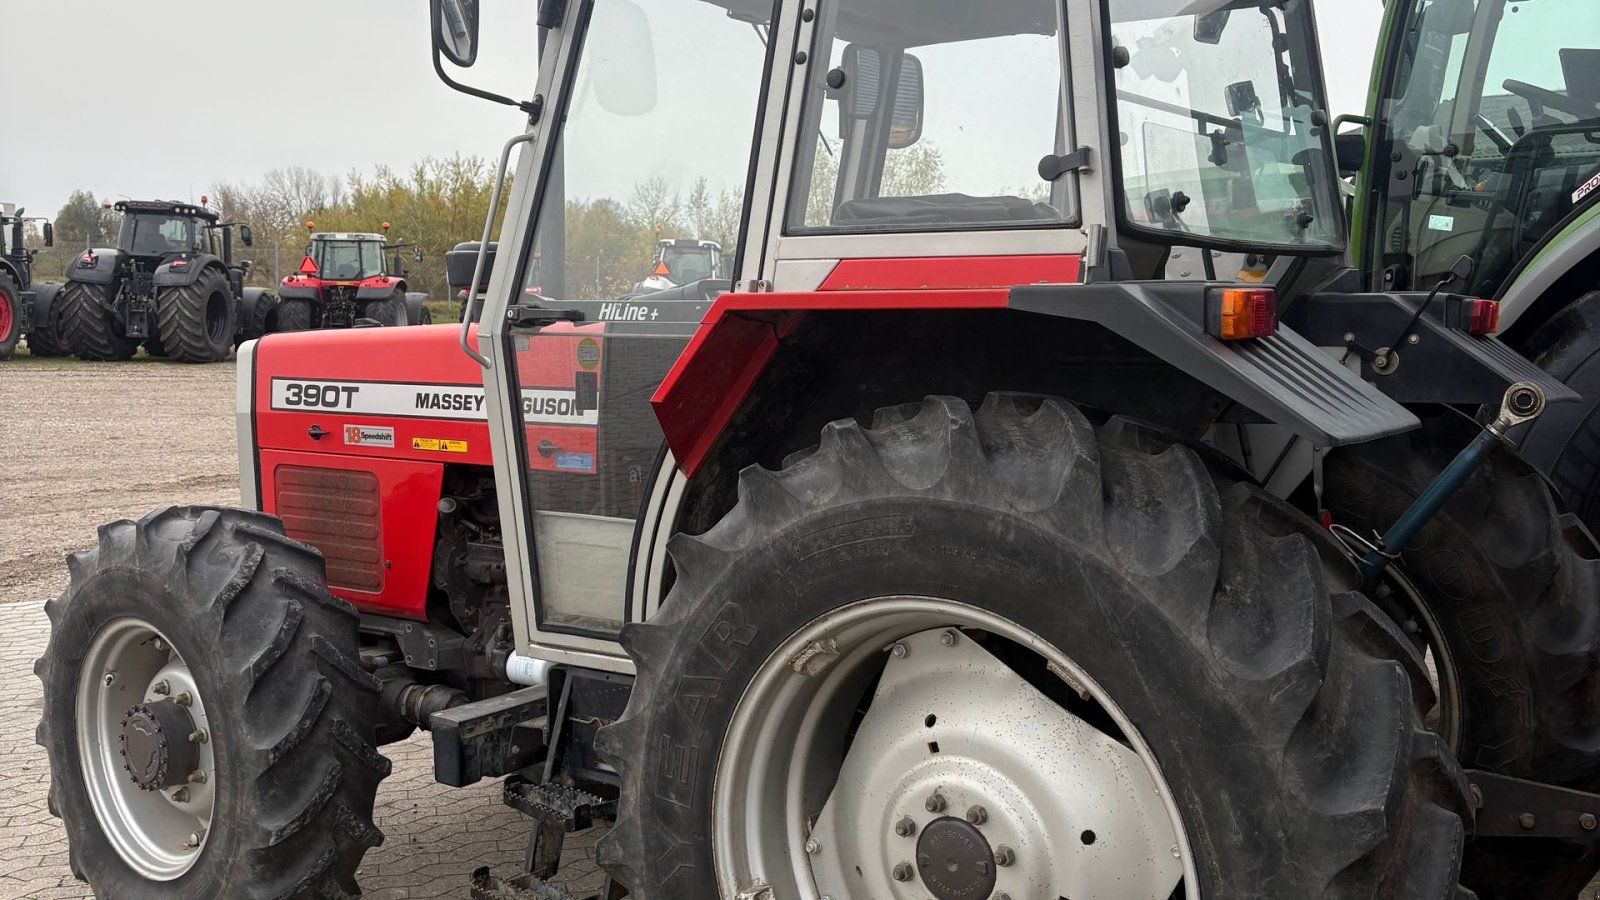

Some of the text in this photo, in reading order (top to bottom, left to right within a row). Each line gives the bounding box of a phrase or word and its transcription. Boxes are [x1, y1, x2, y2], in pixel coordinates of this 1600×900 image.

[1577, 174, 1600, 199] PRO
[285, 384, 359, 409] 390T
[415, 393, 485, 412] MASSEY
[345, 427, 392, 443] 18 Speedshift
